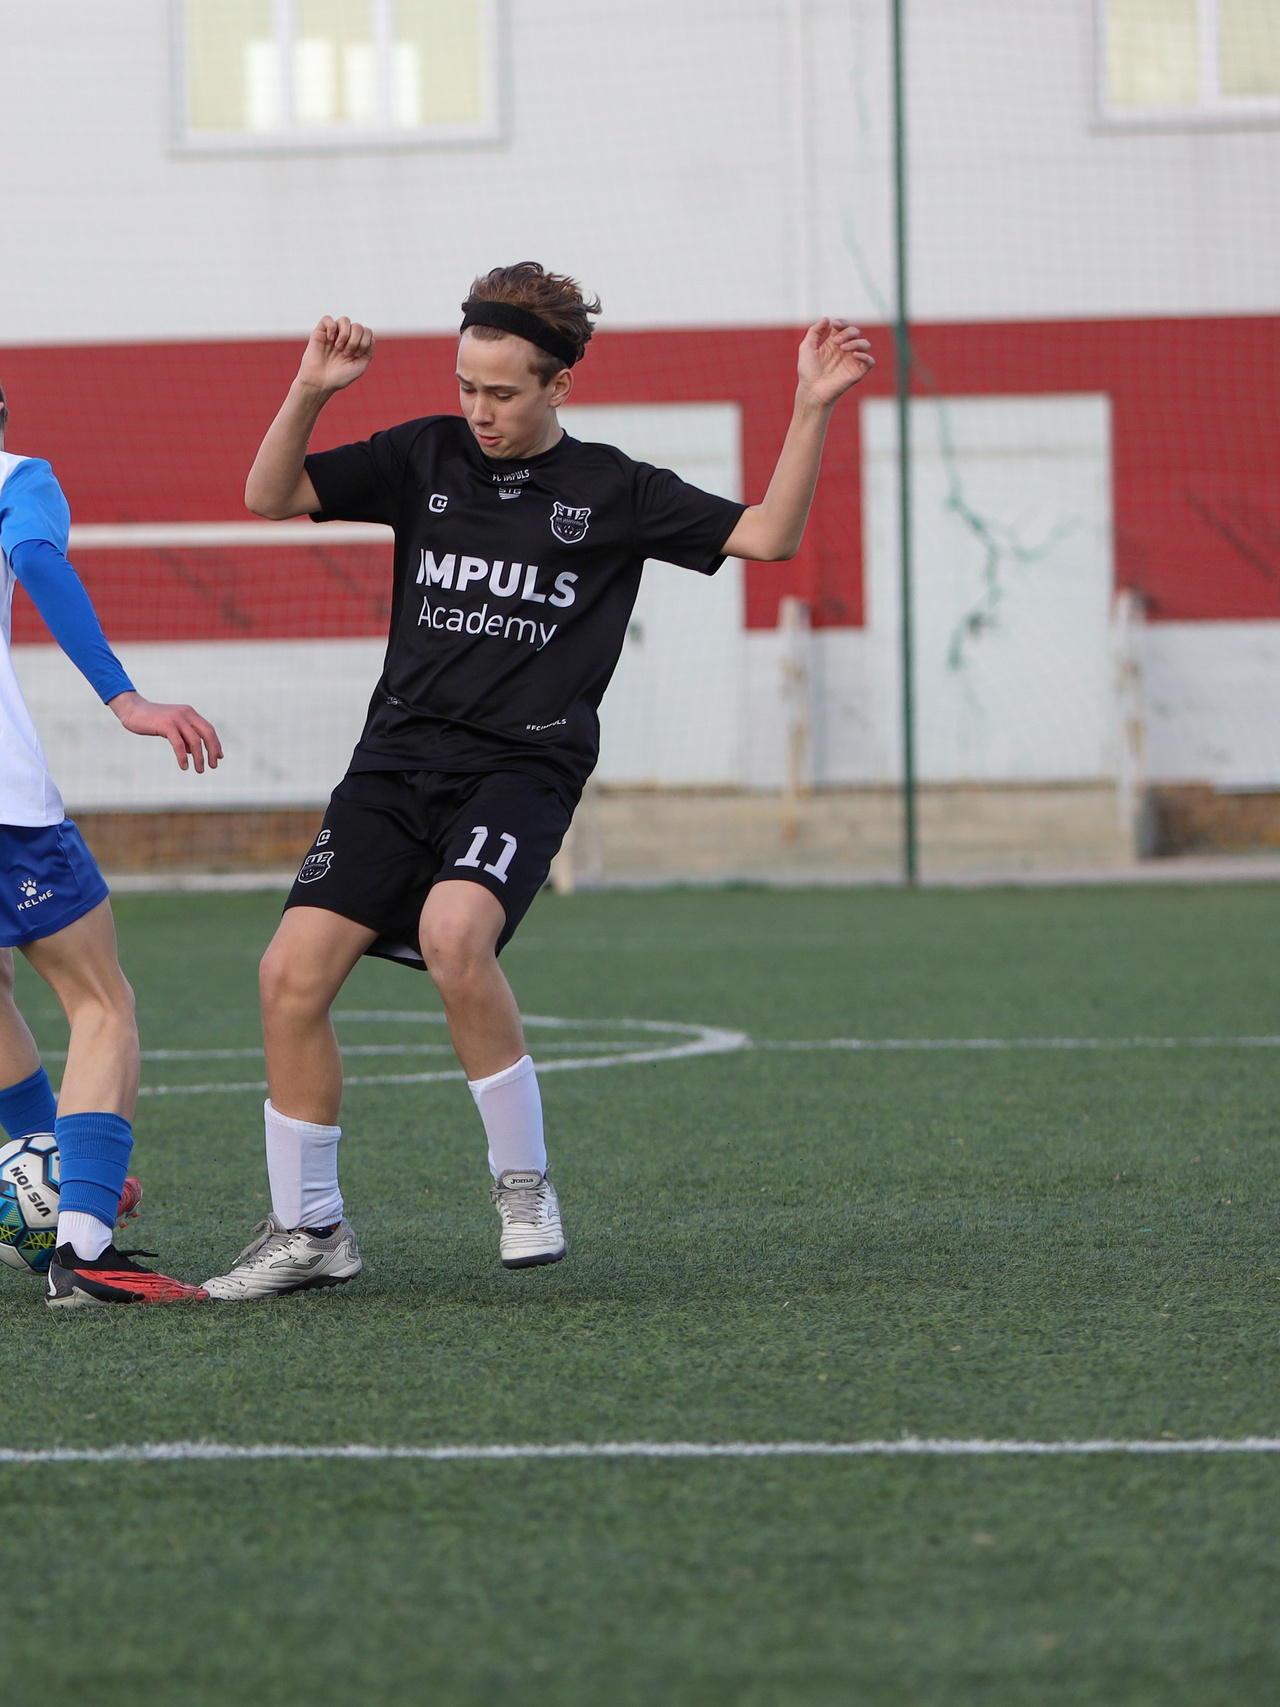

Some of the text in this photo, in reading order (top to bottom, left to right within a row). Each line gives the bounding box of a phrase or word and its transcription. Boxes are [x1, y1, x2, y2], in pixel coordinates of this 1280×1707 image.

[416, 548, 579, 608] IMPULS
[418, 595, 558, 652] Academy
[454, 825, 518, 885] 11
[16, 889, 54, 912] KELME
[10, 1166, 51, 1218] VISION
